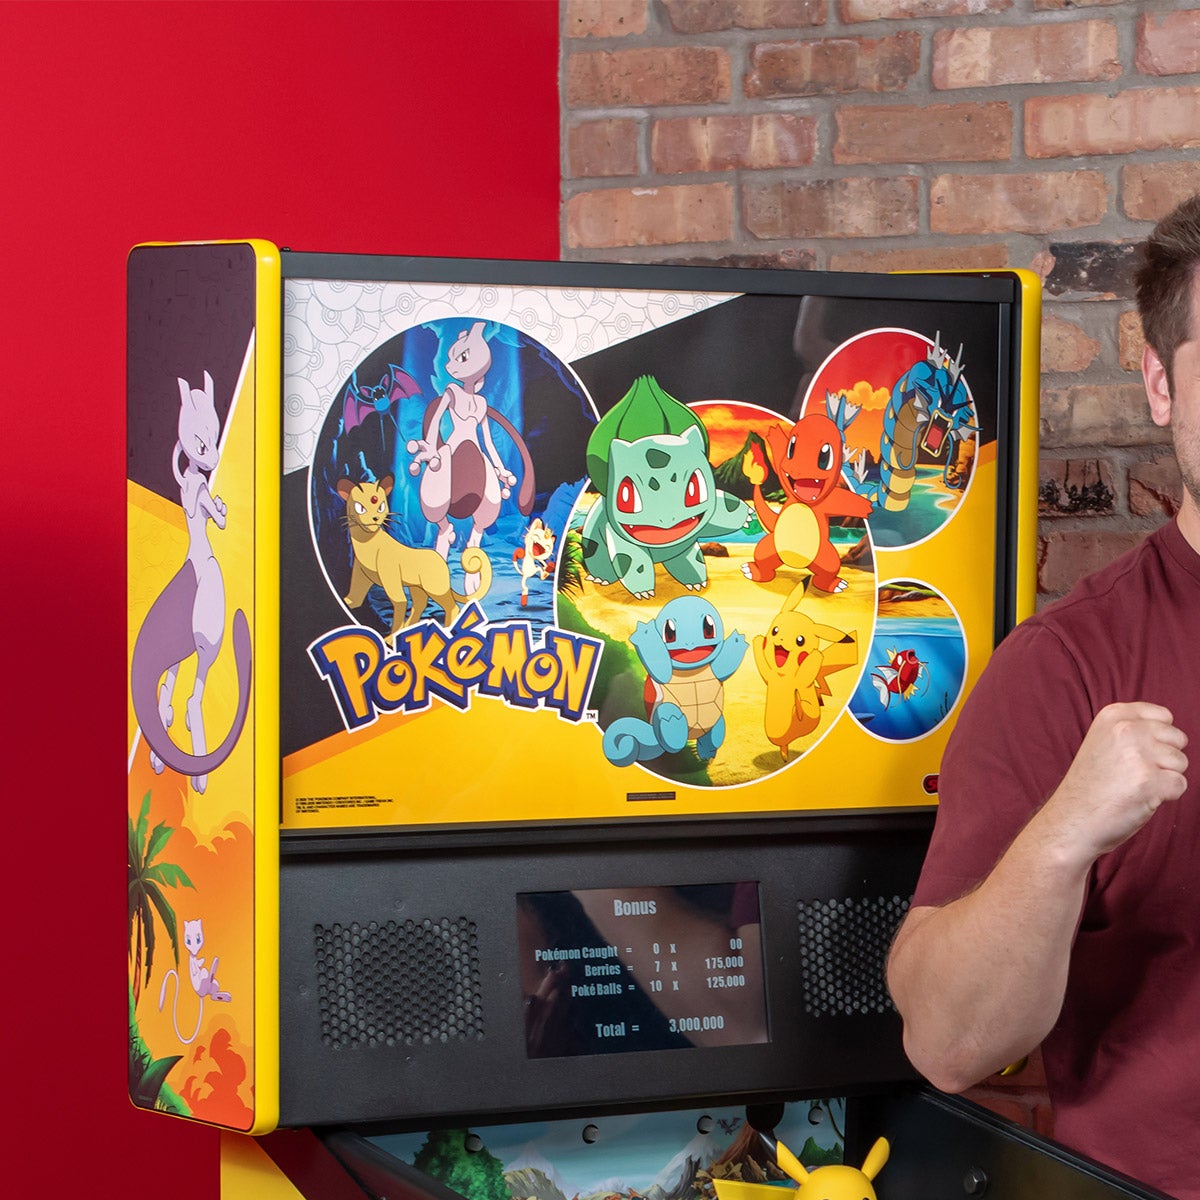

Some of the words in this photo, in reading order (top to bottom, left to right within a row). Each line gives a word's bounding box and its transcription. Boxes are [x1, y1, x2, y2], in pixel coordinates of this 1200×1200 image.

[613, 899, 657, 916] Bonus
[535, 948, 581, 962] Pokémon
[582, 945, 618, 959] Caught
[653, 943, 660, 955] 0
[730, 938, 743, 950] 00
[584, 964, 621, 977] Berries
[654, 960, 660, 973] 7
[705, 956, 744, 970] 175,000
[571, 983, 597, 998] Poké
[597, 982, 622, 996] Balls
[650, 980, 663, 993] 10
[707, 974, 746, 989] 125,000
[595, 1022, 626, 1038] Total
[669, 1015, 725, 1034] 3,000,000
